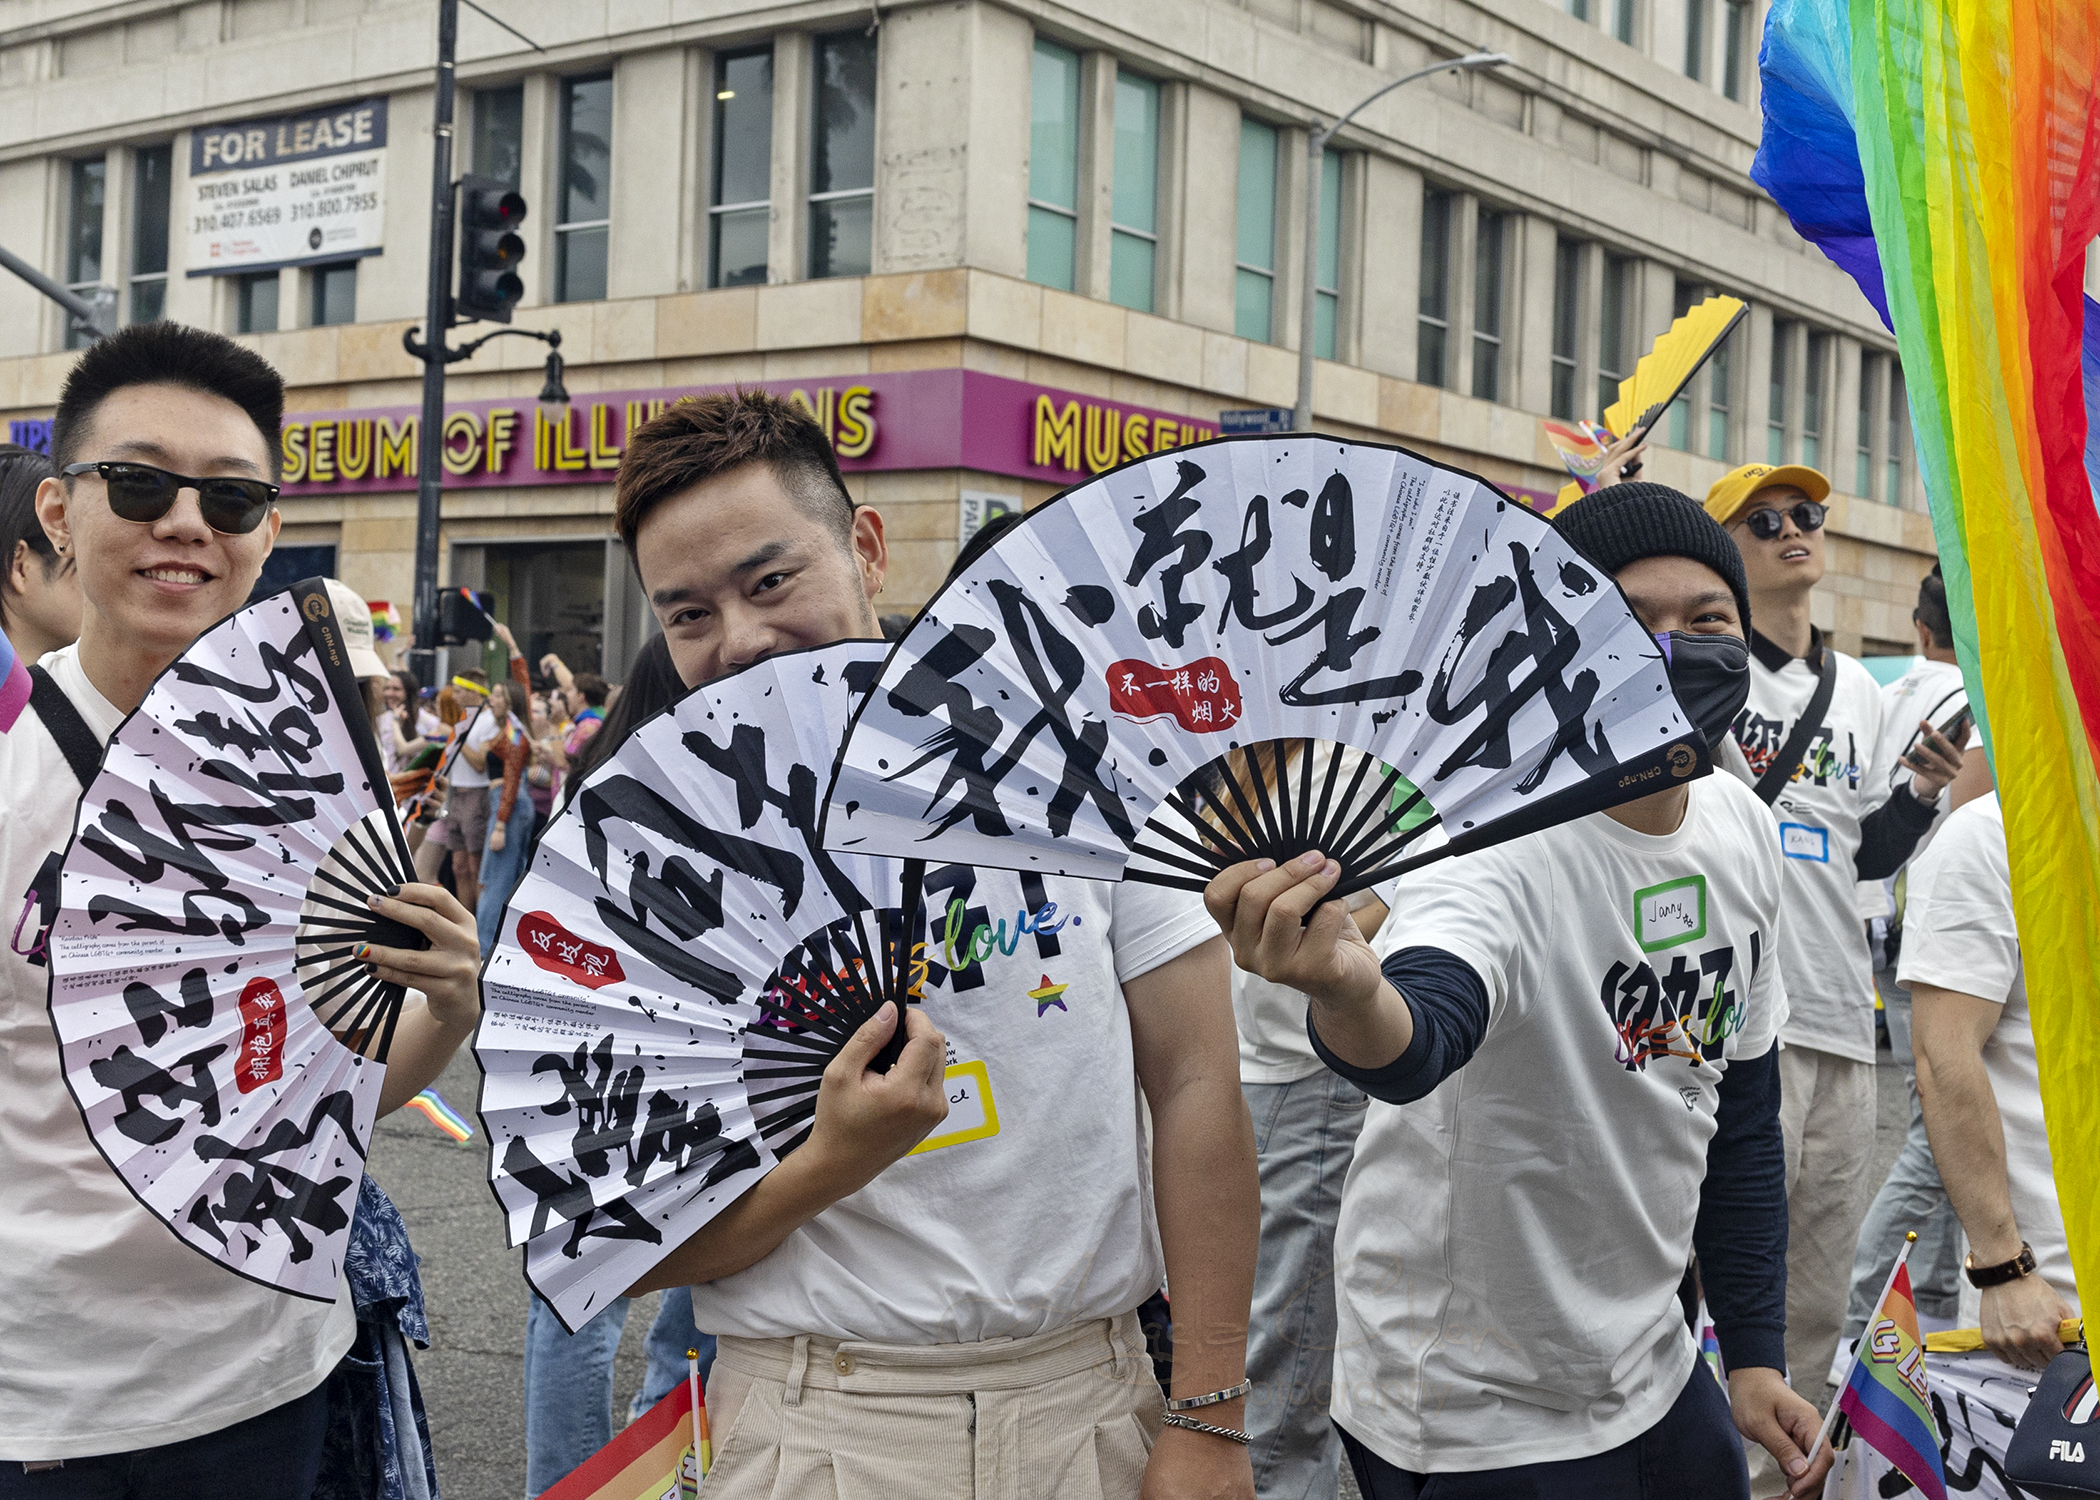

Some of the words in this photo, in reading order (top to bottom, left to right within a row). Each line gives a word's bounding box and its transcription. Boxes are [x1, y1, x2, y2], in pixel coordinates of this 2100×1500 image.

[202, 130, 266, 167] FOR
[275, 109, 373, 157] LEASE
[198, 182, 239, 202] STEVEN
[243, 175, 278, 195] SALAS
[290, 167, 328, 187] DANIEL
[1222, 412, 1269, 428] Hollywood
[281, 415, 419, 484] SEUM
[442, 407, 516, 475] OF
[1396, 481, 1406, 504] Chinese
[1399, 488, 1414, 521] calligraphy
[1412, 498, 1420, 510] who
[1389, 506, 1400, 533] LGBTQ+
[1396, 523, 1404, 539] comes
[1379, 534, 1391, 566] community
[1391, 542, 1400, 555] from
[1374, 568, 1384, 590] member
[1384, 568, 1393, 588] parent
[321, 626, 340, 666] CRN.ngo
[1120, 669, 1221, 696] 不一样的
[1191, 699, 1241, 726] 烟火
[1618, 766, 1661, 788] CRN.ngo
[944, 897, 1083, 972] love.
[71, 943, 101, 951] calligraphy
[529, 928, 610, 978] 反歧视
[502, 990, 532, 1000] calligraphy
[521, 999, 544, 1008] LGBTQ+
[546, 1005, 574, 1013] community
[247, 989, 280, 1084] 拥抱真我
[2049, 1439, 2085, 1463] FILA
